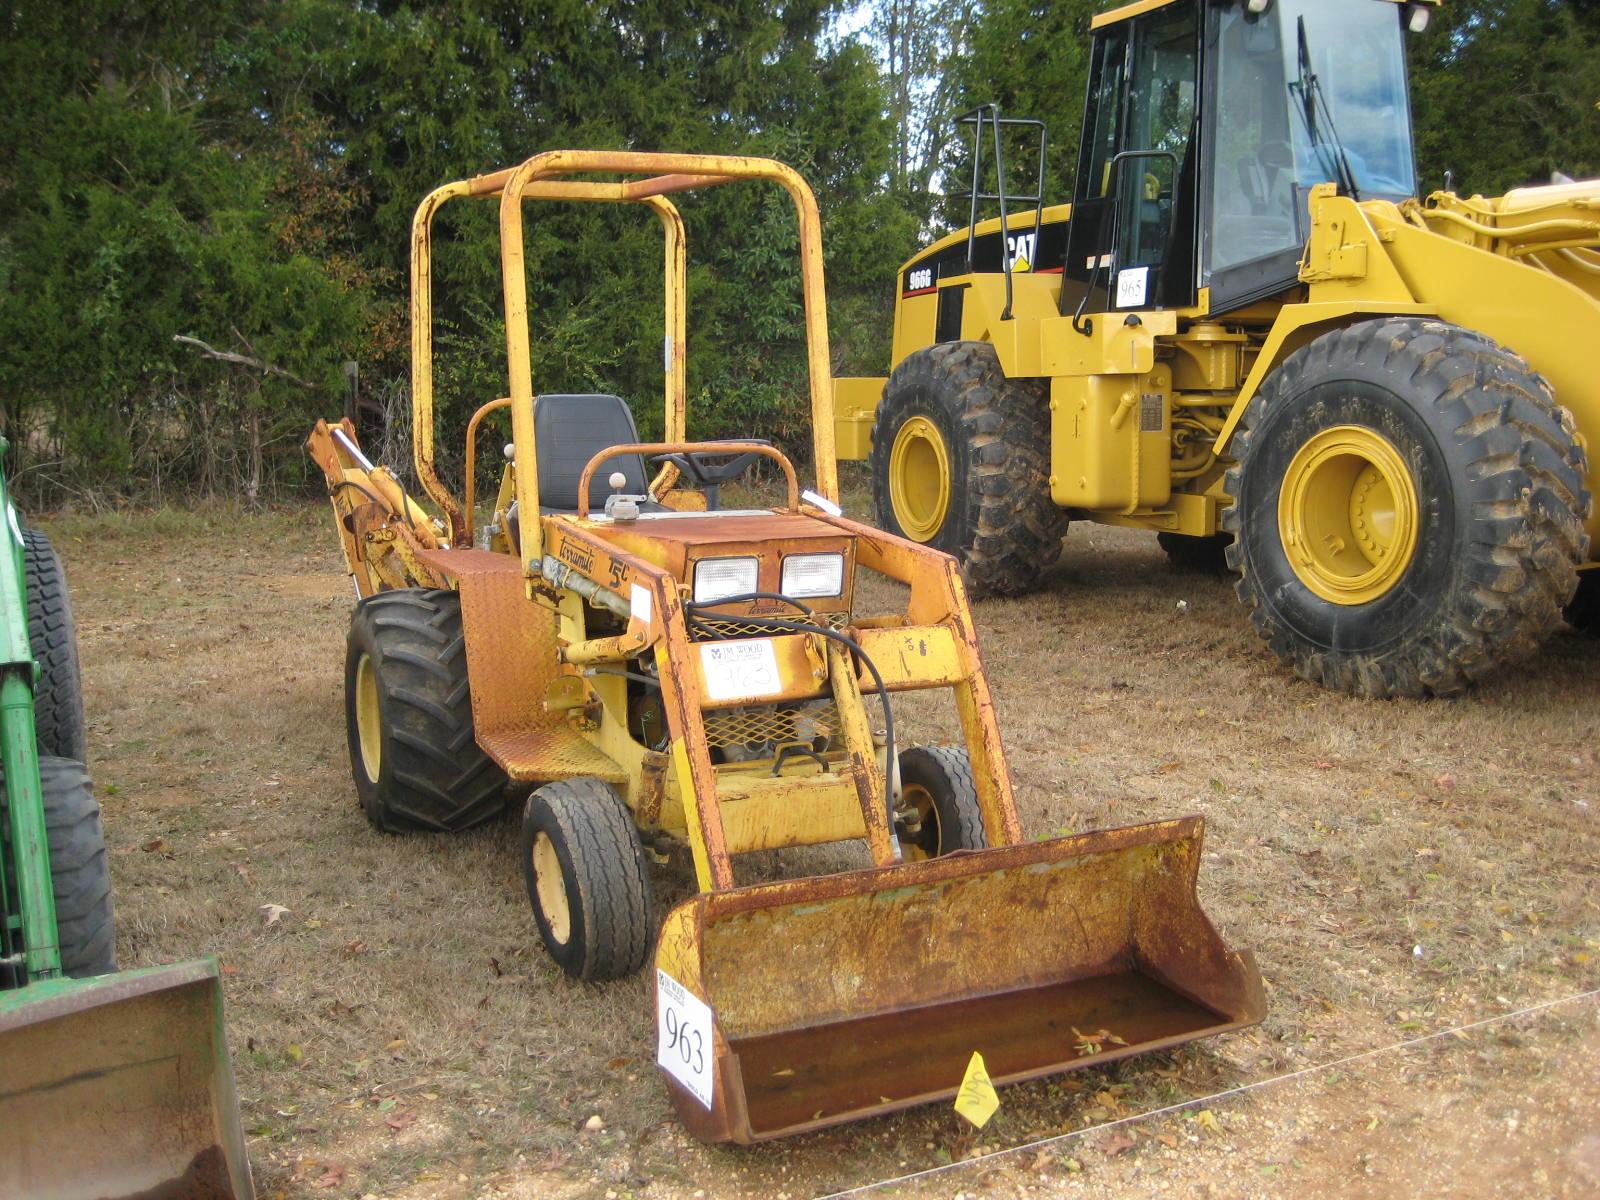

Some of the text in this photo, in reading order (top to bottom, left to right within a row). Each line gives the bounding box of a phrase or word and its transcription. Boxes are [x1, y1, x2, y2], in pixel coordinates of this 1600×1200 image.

[1003, 234, 1036, 272] CAT
[910, 268, 931, 290] 966G
[1121, 279, 1142, 298] 965
[666, 1007, 704, 1075] 963
